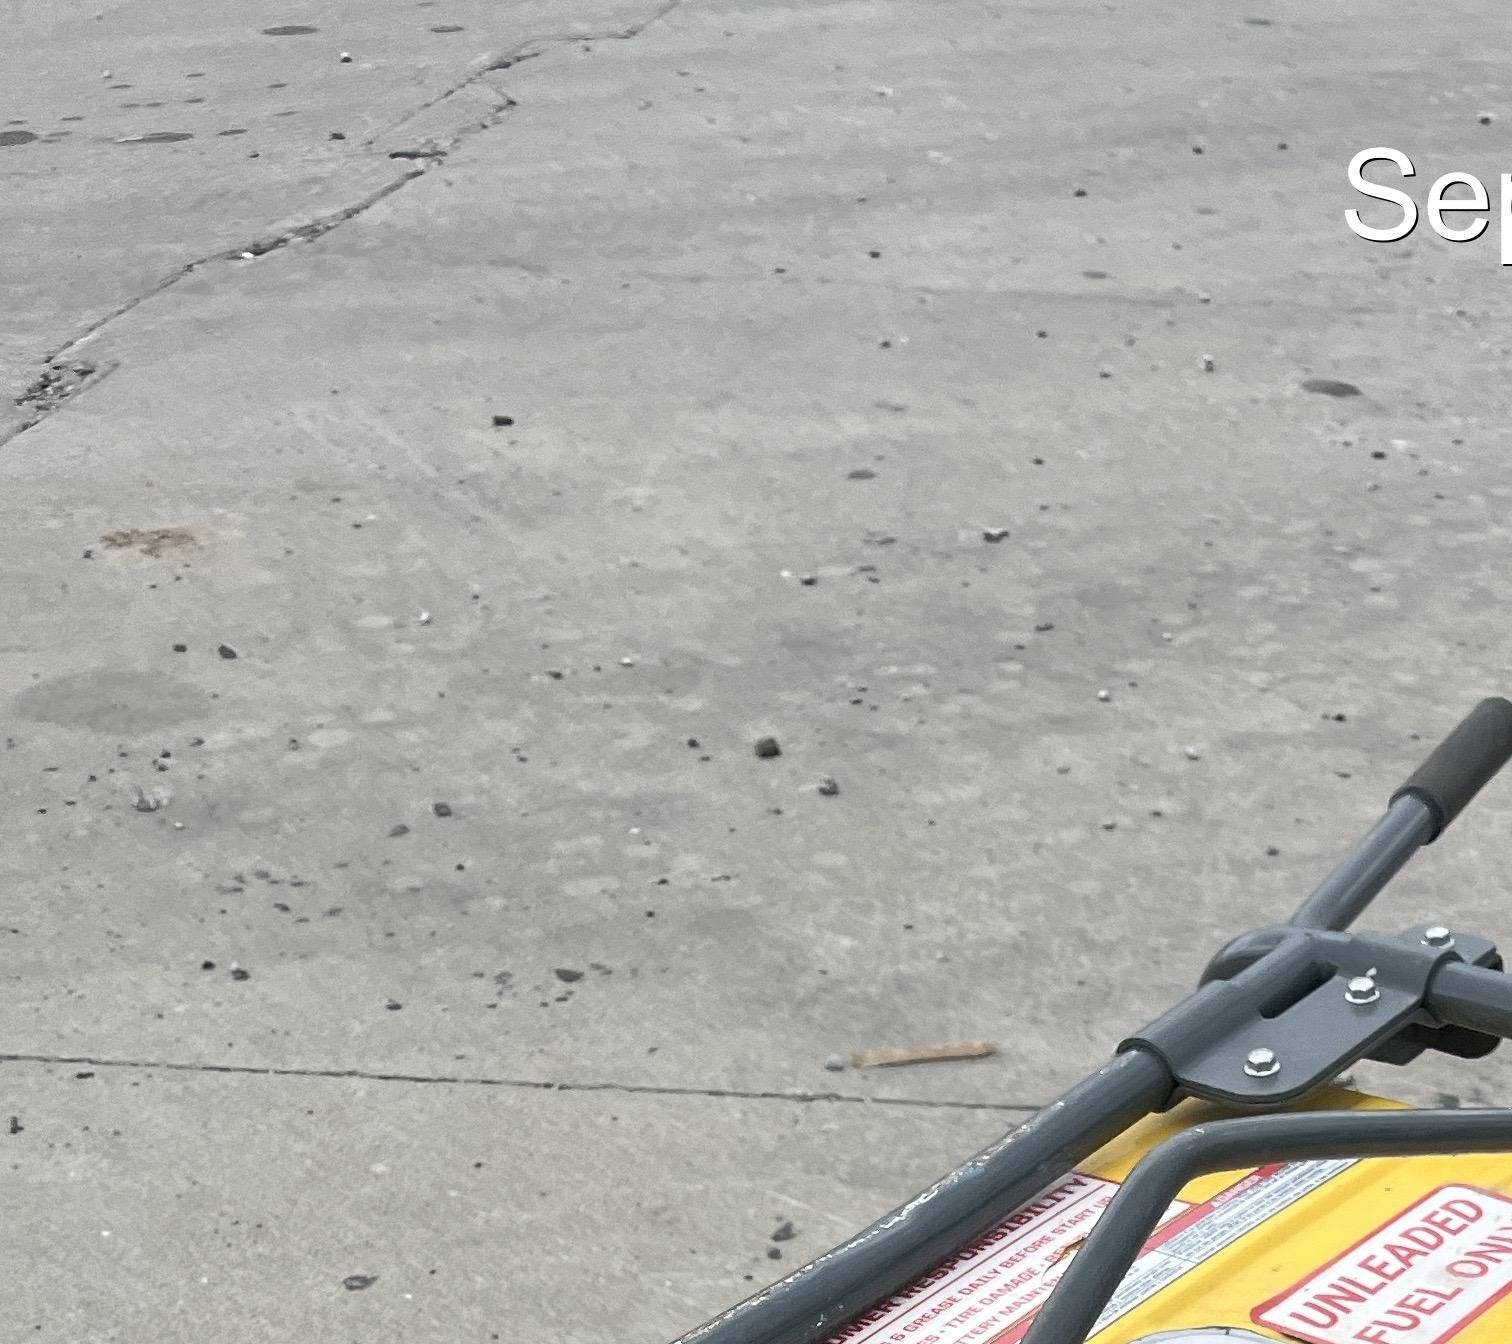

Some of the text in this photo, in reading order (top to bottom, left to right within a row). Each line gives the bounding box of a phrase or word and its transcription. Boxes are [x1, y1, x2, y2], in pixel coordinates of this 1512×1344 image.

[903, 1296, 962, 1333] GREASE
[957, 1269, 1003, 1297] DAILY
[999, 1235, 1055, 1268] BEFORE
[1051, 1208, 1096, 1236] START
[942, 1304, 984, 1330] TIRE
[979, 1267, 1042, 1305] DAMAGE
[1289, 1198, 1484, 1330] UNLEADED
